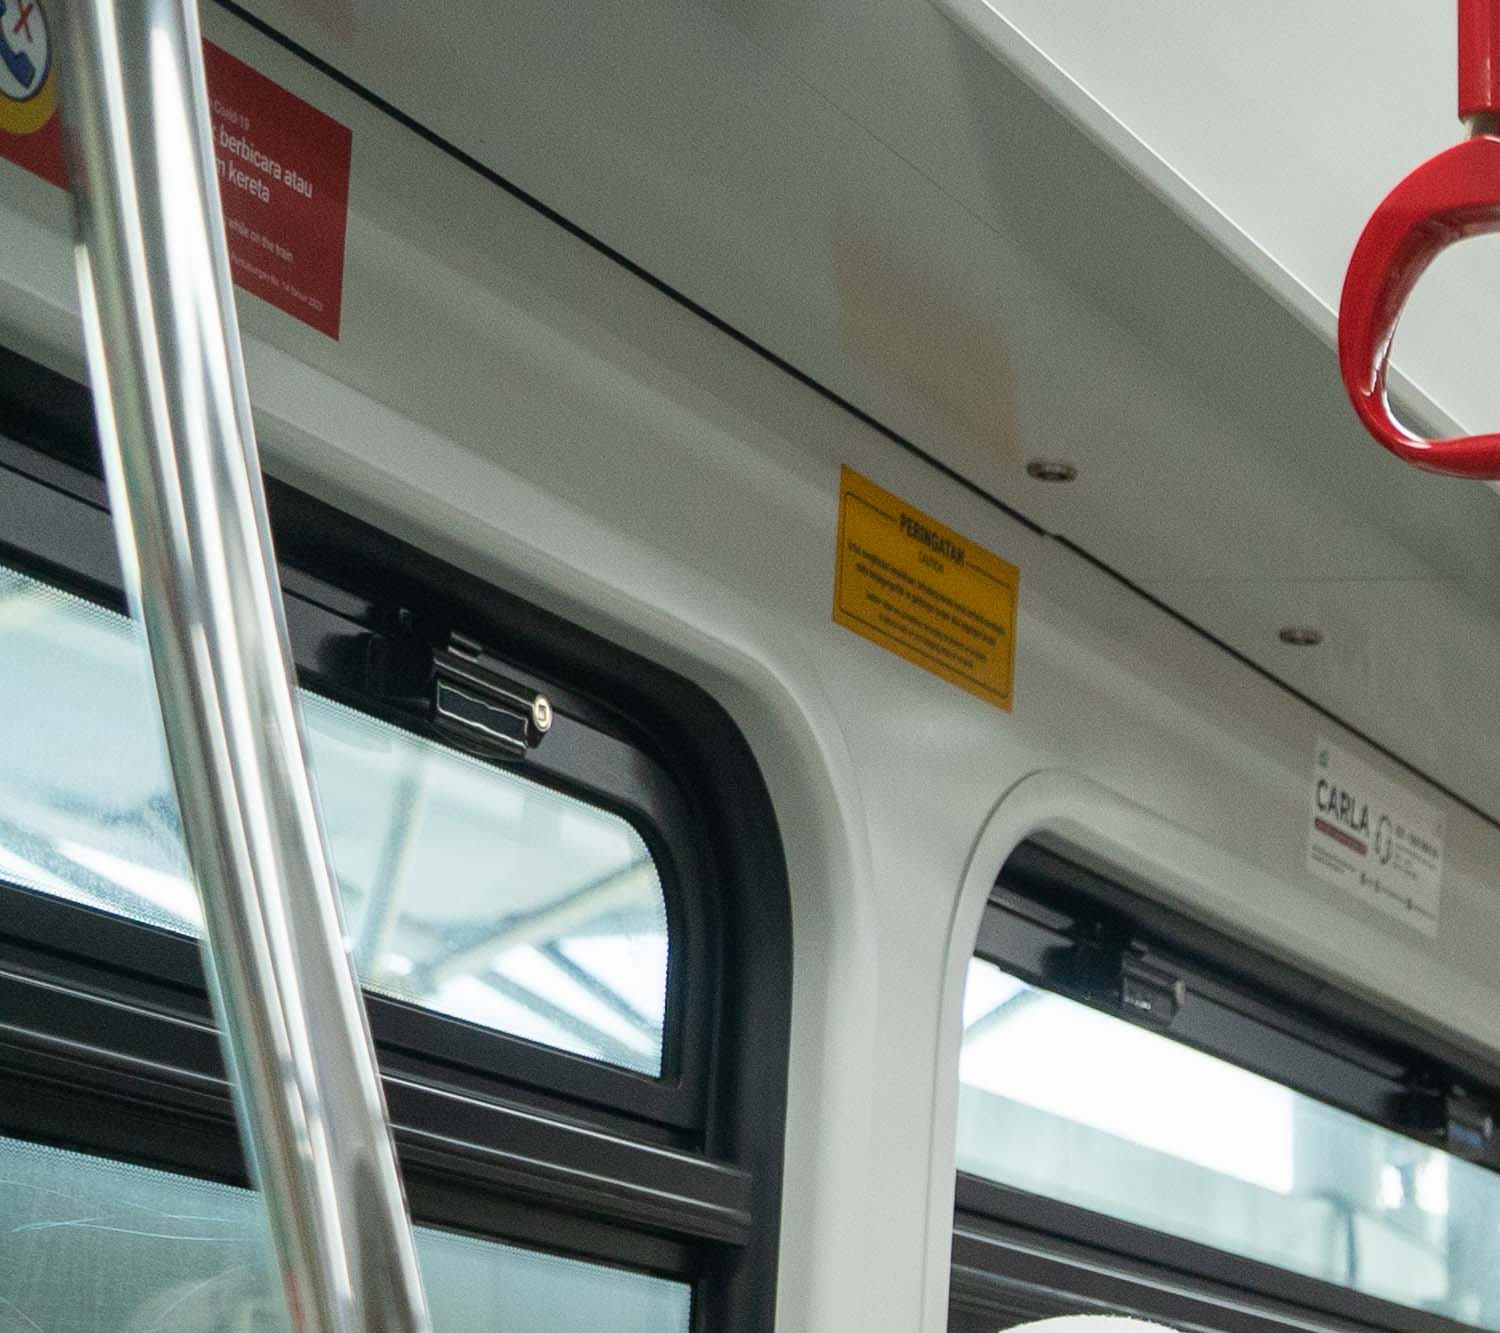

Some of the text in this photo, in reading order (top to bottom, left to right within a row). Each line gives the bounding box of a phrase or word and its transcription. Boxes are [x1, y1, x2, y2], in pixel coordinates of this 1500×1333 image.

[220, 124, 282, 180] berbicara
[283, 169, 313, 199] atau
[228, 159, 271, 203] kereta
[1316, 778, 1370, 836] CARLA
